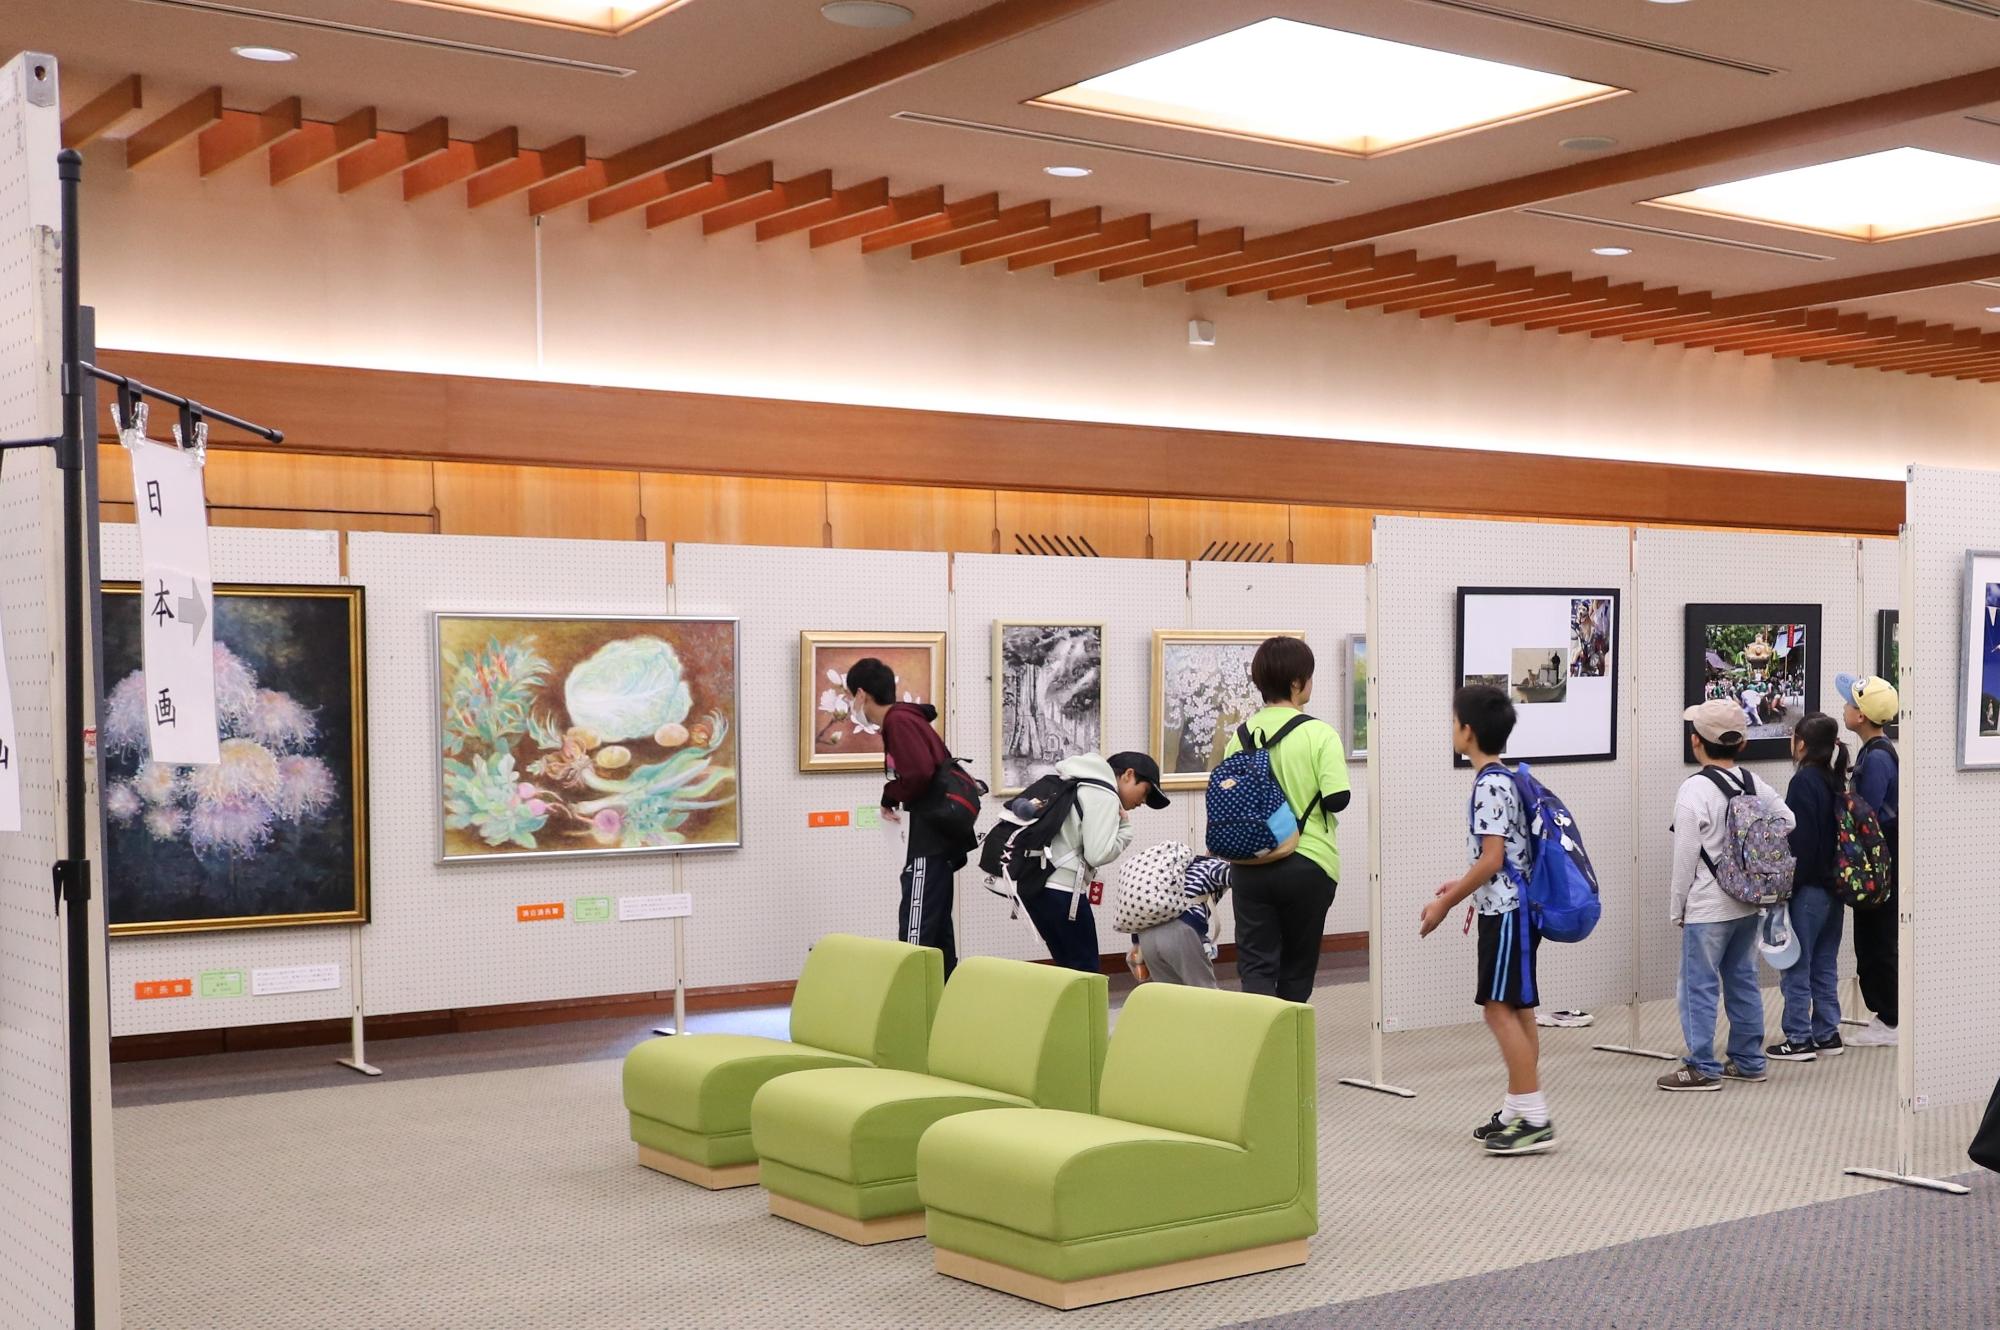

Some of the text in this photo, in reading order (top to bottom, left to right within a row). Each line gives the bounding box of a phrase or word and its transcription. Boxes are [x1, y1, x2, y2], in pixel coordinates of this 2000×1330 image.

[147, 480, 176, 728] 日本画
[1781, 1044, 1791, 1054] N
[1677, 1070, 1690, 1082] N
